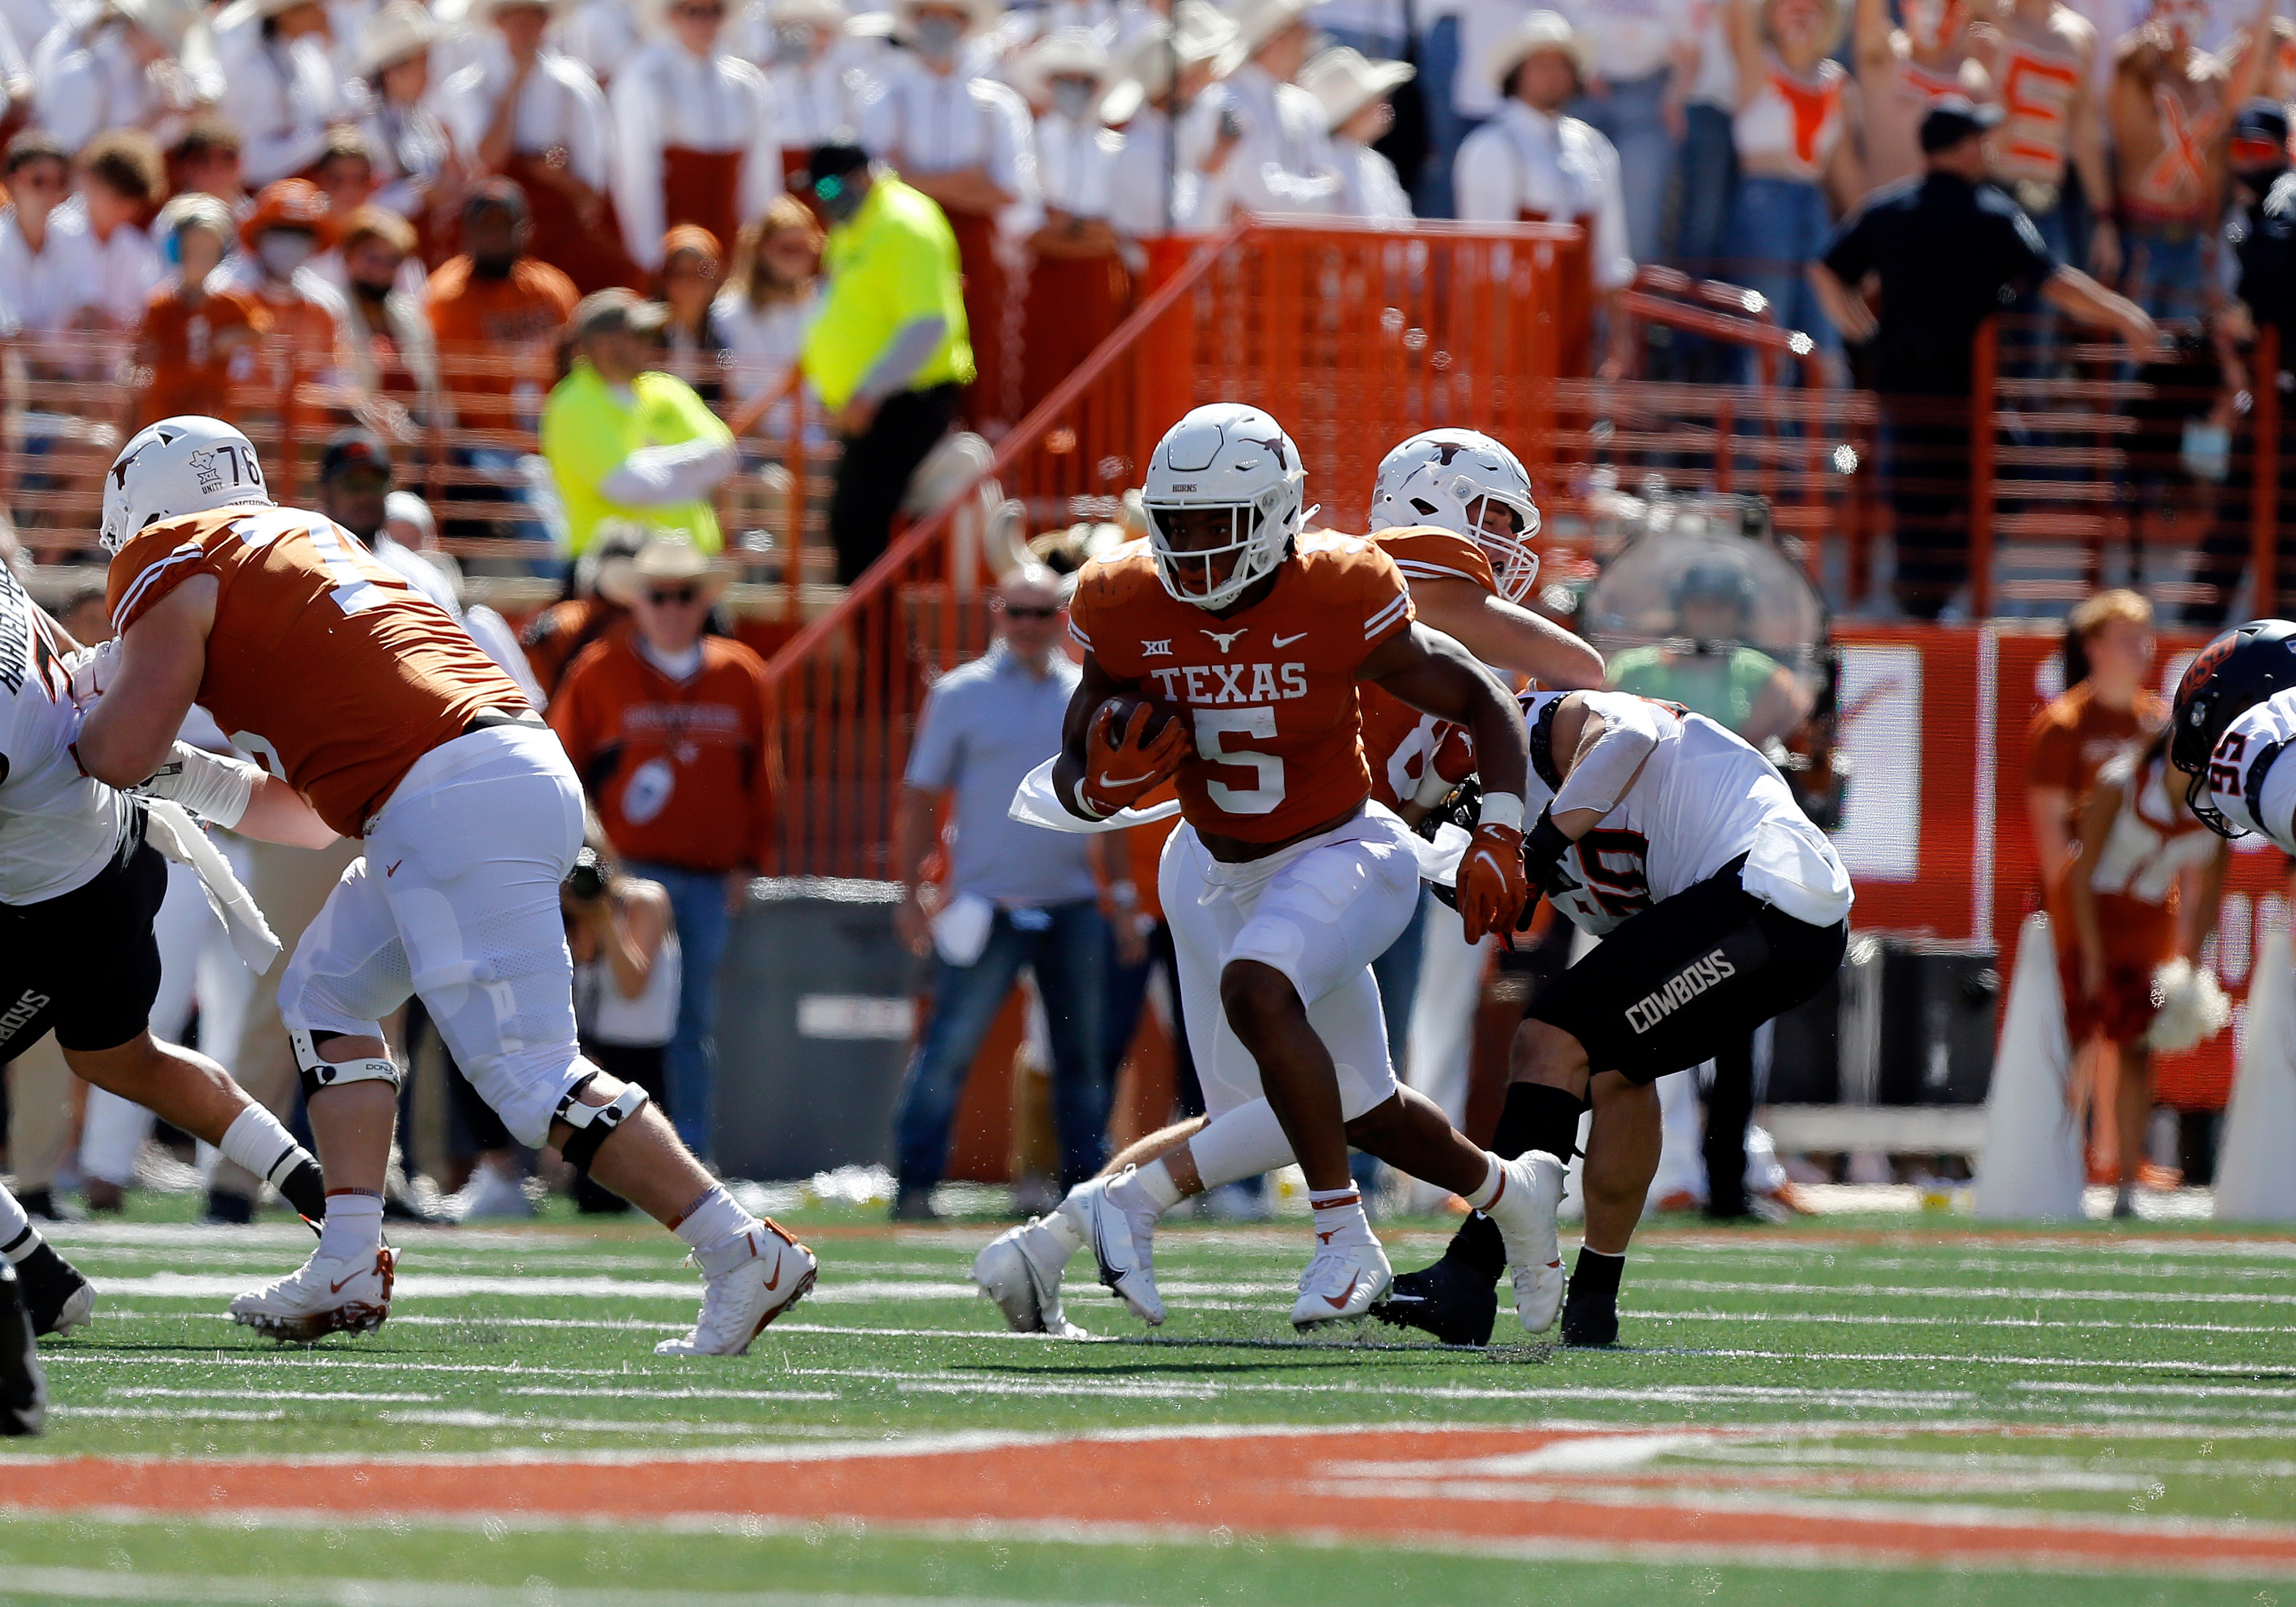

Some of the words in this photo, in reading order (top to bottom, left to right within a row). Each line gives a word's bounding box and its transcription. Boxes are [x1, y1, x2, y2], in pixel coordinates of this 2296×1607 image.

[216, 445, 260, 486] 76
[202, 482, 223, 495] UNITY
[1172, 483, 1198, 492] HORNS
[1141, 639, 1173, 656] XII
[1151, 662, 1307, 703] TEXAS
[1192, 706, 1286, 814] 5
[2208, 731, 2248, 797] 95
[1625, 948, 1736, 1034] COWBOYS
[0, 989, 50, 1047] BOYS
